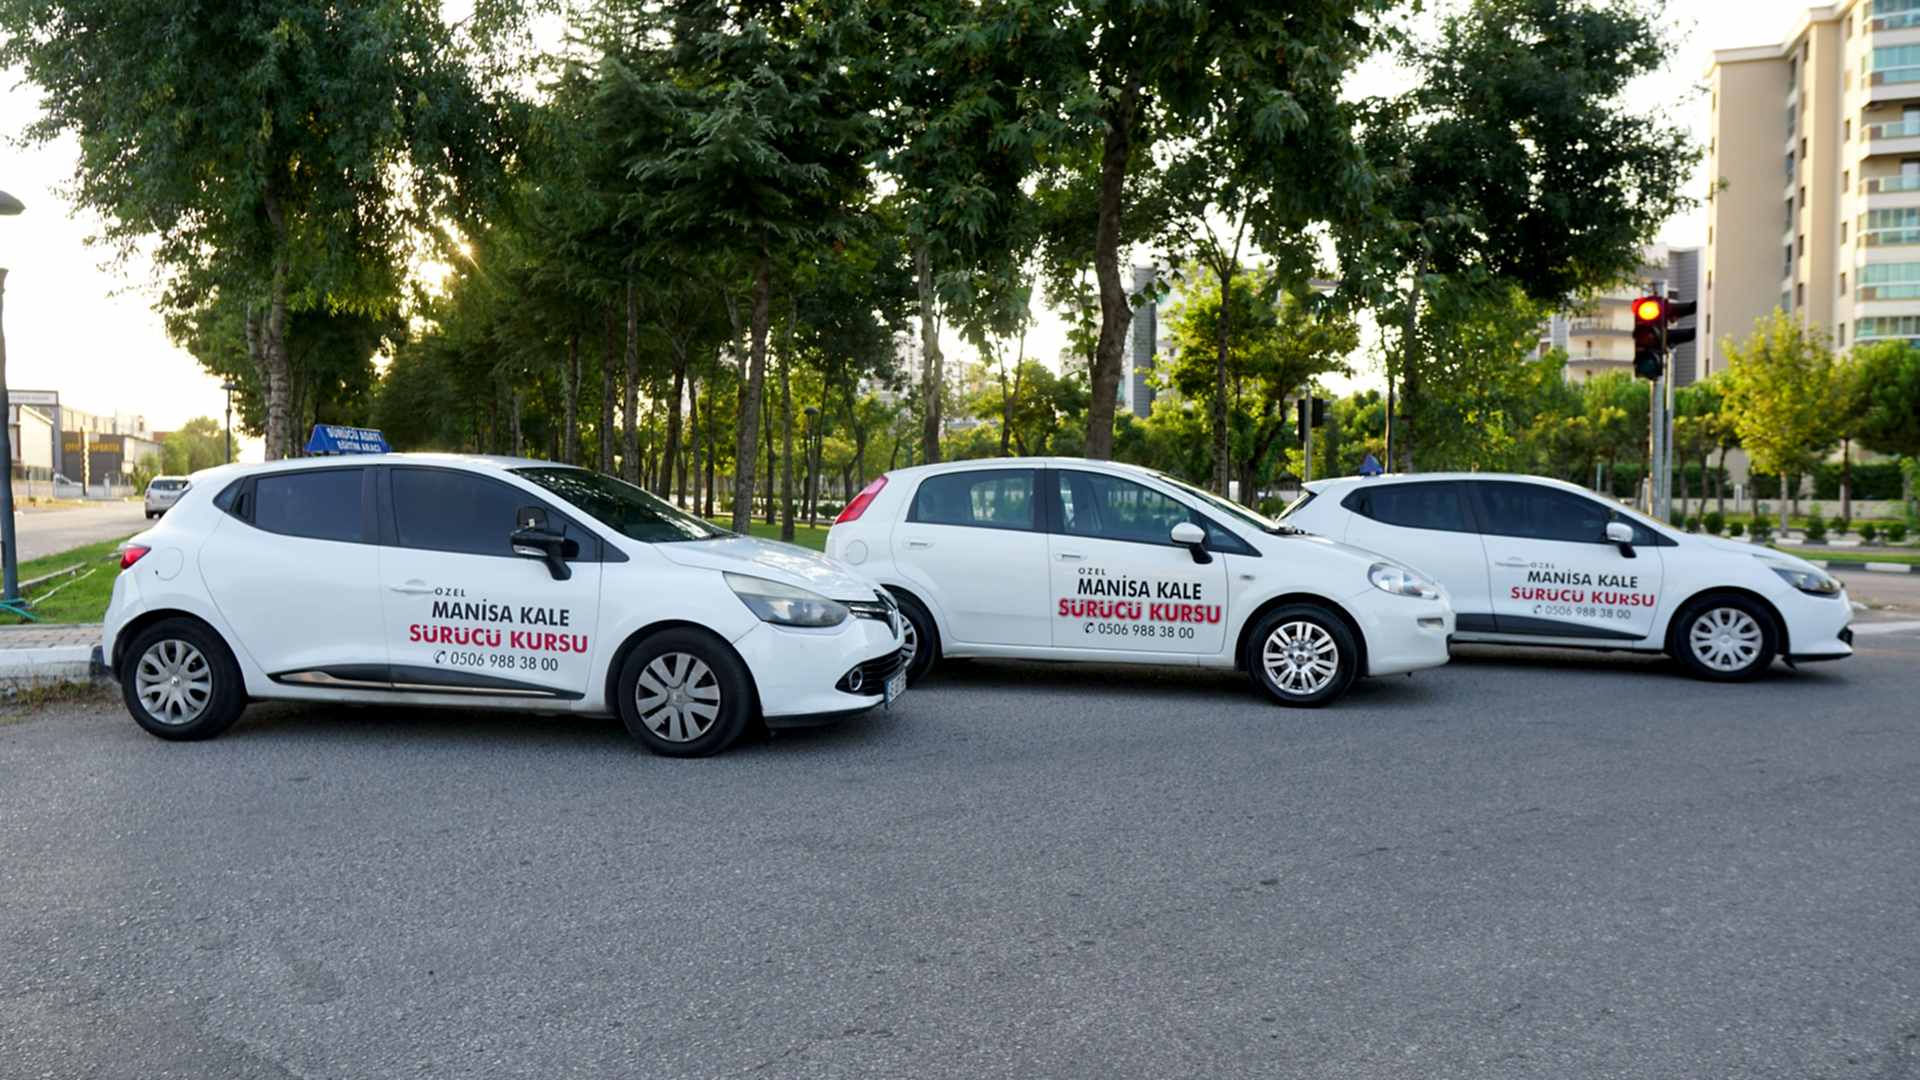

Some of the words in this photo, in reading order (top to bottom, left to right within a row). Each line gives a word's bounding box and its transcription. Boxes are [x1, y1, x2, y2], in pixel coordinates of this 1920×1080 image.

[1077, 575, 1150, 598] MANİSA
[1157, 582, 1202, 600] KALE
[1527, 568, 1592, 586] MANİSA
[1598, 574, 1638, 588] KALE
[1591, 591, 1655, 607] KURSU
[432, 599, 513, 623] MANİSA
[520, 607, 570, 627] KALE
[1058, 598, 1142, 620] SÜRÜCÜ
[1149, 602, 1222, 624] KURSU
[1545, 605, 1572, 616] 0506
[1576, 606, 1596, 617] 988
[1600, 608, 1613, 618] 38
[1616, 608, 1631, 620] 00
[410, 624, 501, 647] SÜRÜCÜ
[510, 631, 588, 653] KURSU
[1098, 623, 1129, 636] 0506
[1132, 624, 1155, 637] 988
[1159, 626, 1175, 638] 38
[1178, 627, 1195, 639] 00
[450, 651, 485, 667] 0506
[489, 654, 515, 669] 988
[519, 656, 537, 671] 38
[541, 657, 559, 672] 00
